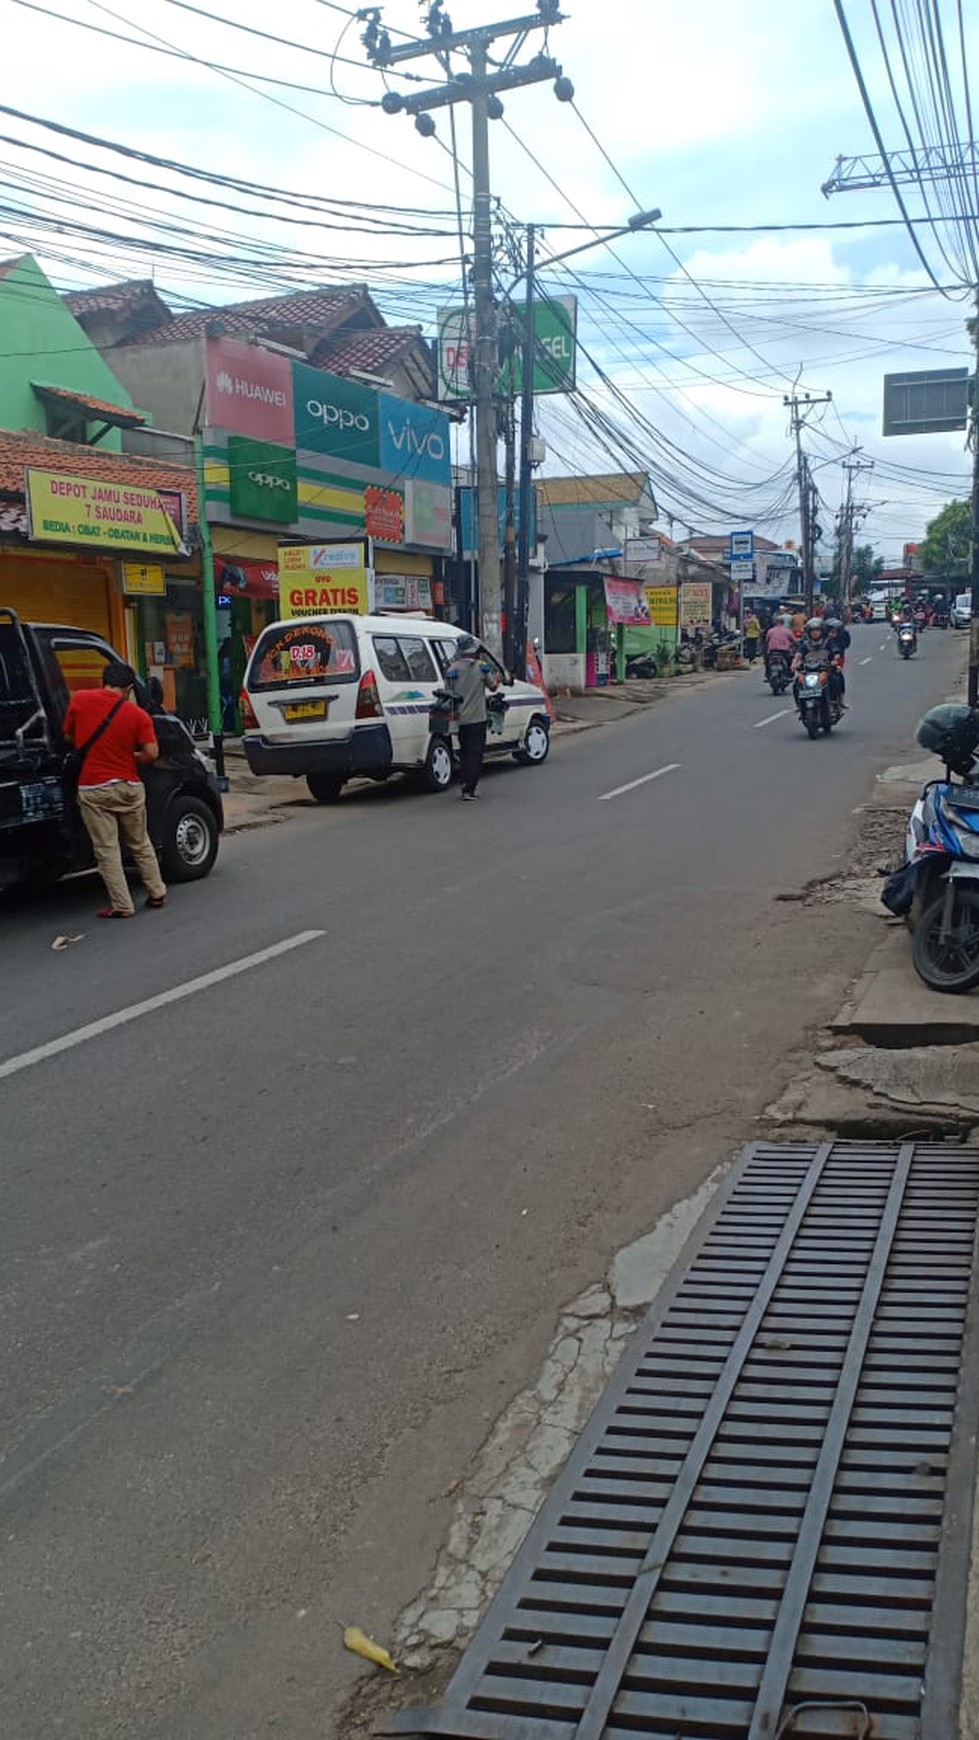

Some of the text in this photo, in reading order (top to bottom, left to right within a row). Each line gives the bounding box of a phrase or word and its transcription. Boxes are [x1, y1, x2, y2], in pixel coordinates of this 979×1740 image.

[235, 380, 287, 408] HUAWEI
[306, 399, 370, 432] oppo
[388, 419, 444, 460] vivo
[50, 480, 87, 499] DEPOT
[91, 486, 121, 504] JAMU
[248, 470, 291, 491] oppo
[85, 504, 143, 525] 7 SAUDARA
[289, 586, 359, 607] GRATIS
